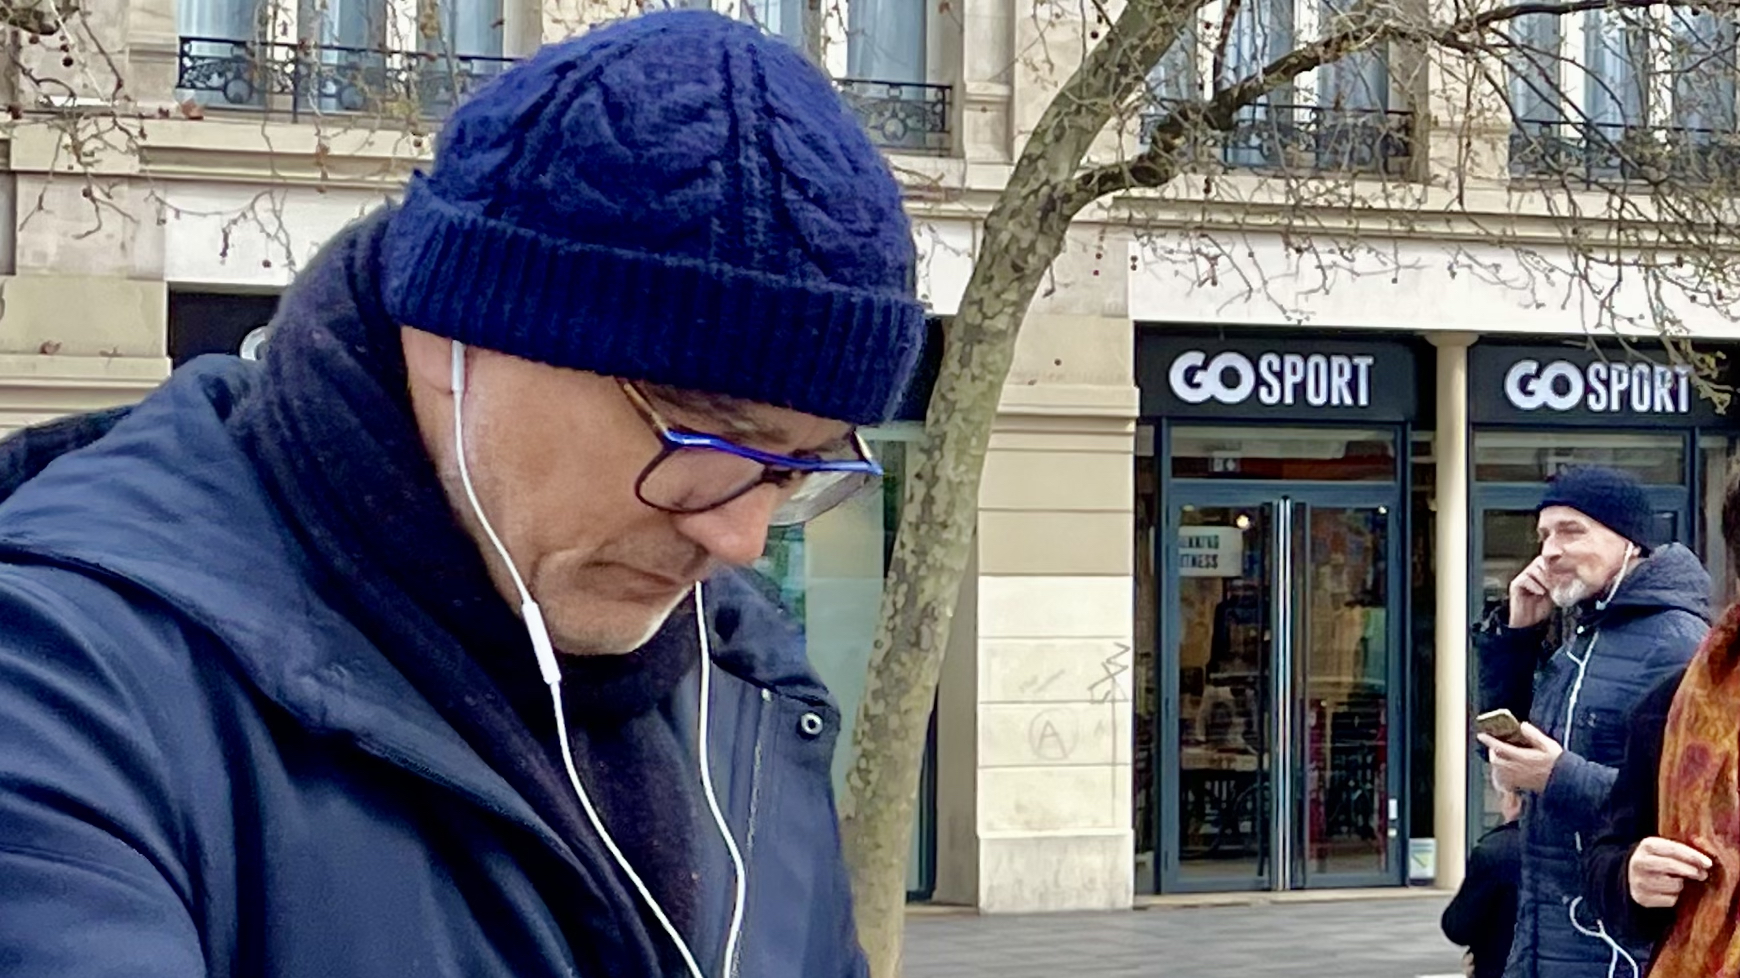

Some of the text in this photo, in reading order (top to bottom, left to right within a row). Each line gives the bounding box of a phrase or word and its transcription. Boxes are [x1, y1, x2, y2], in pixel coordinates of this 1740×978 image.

[1169, 351, 1374, 407] GO SPORT
[1504, 359, 1694, 413] GO SPORT
